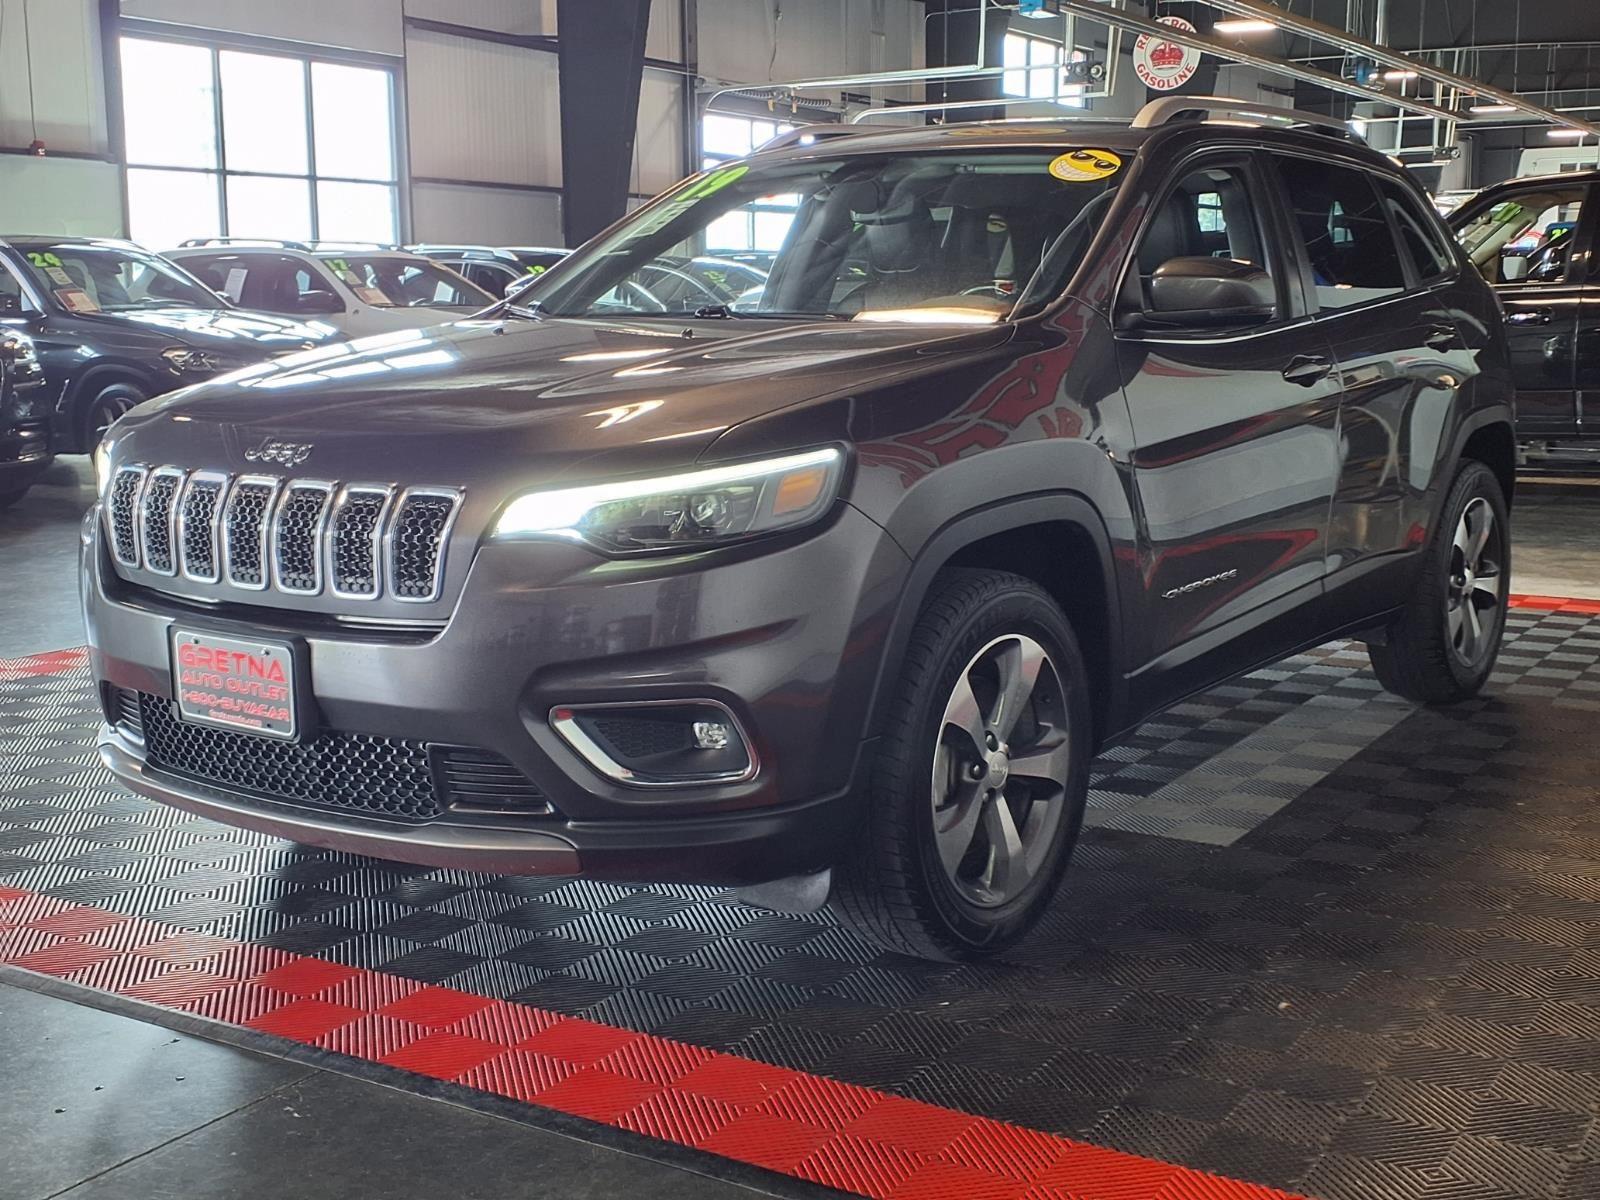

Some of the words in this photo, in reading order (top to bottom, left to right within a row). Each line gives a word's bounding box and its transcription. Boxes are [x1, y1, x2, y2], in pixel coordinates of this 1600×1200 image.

[1137, 63, 1195, 88] GASOLINE
[244, 436, 314, 468] Jeep
[1161, 568, 1237, 599] CHEROKEE
[180, 643, 286, 683] GRETNA
[181, 669, 223, 690] AUTO
[226, 677, 289, 702] OUTLET
